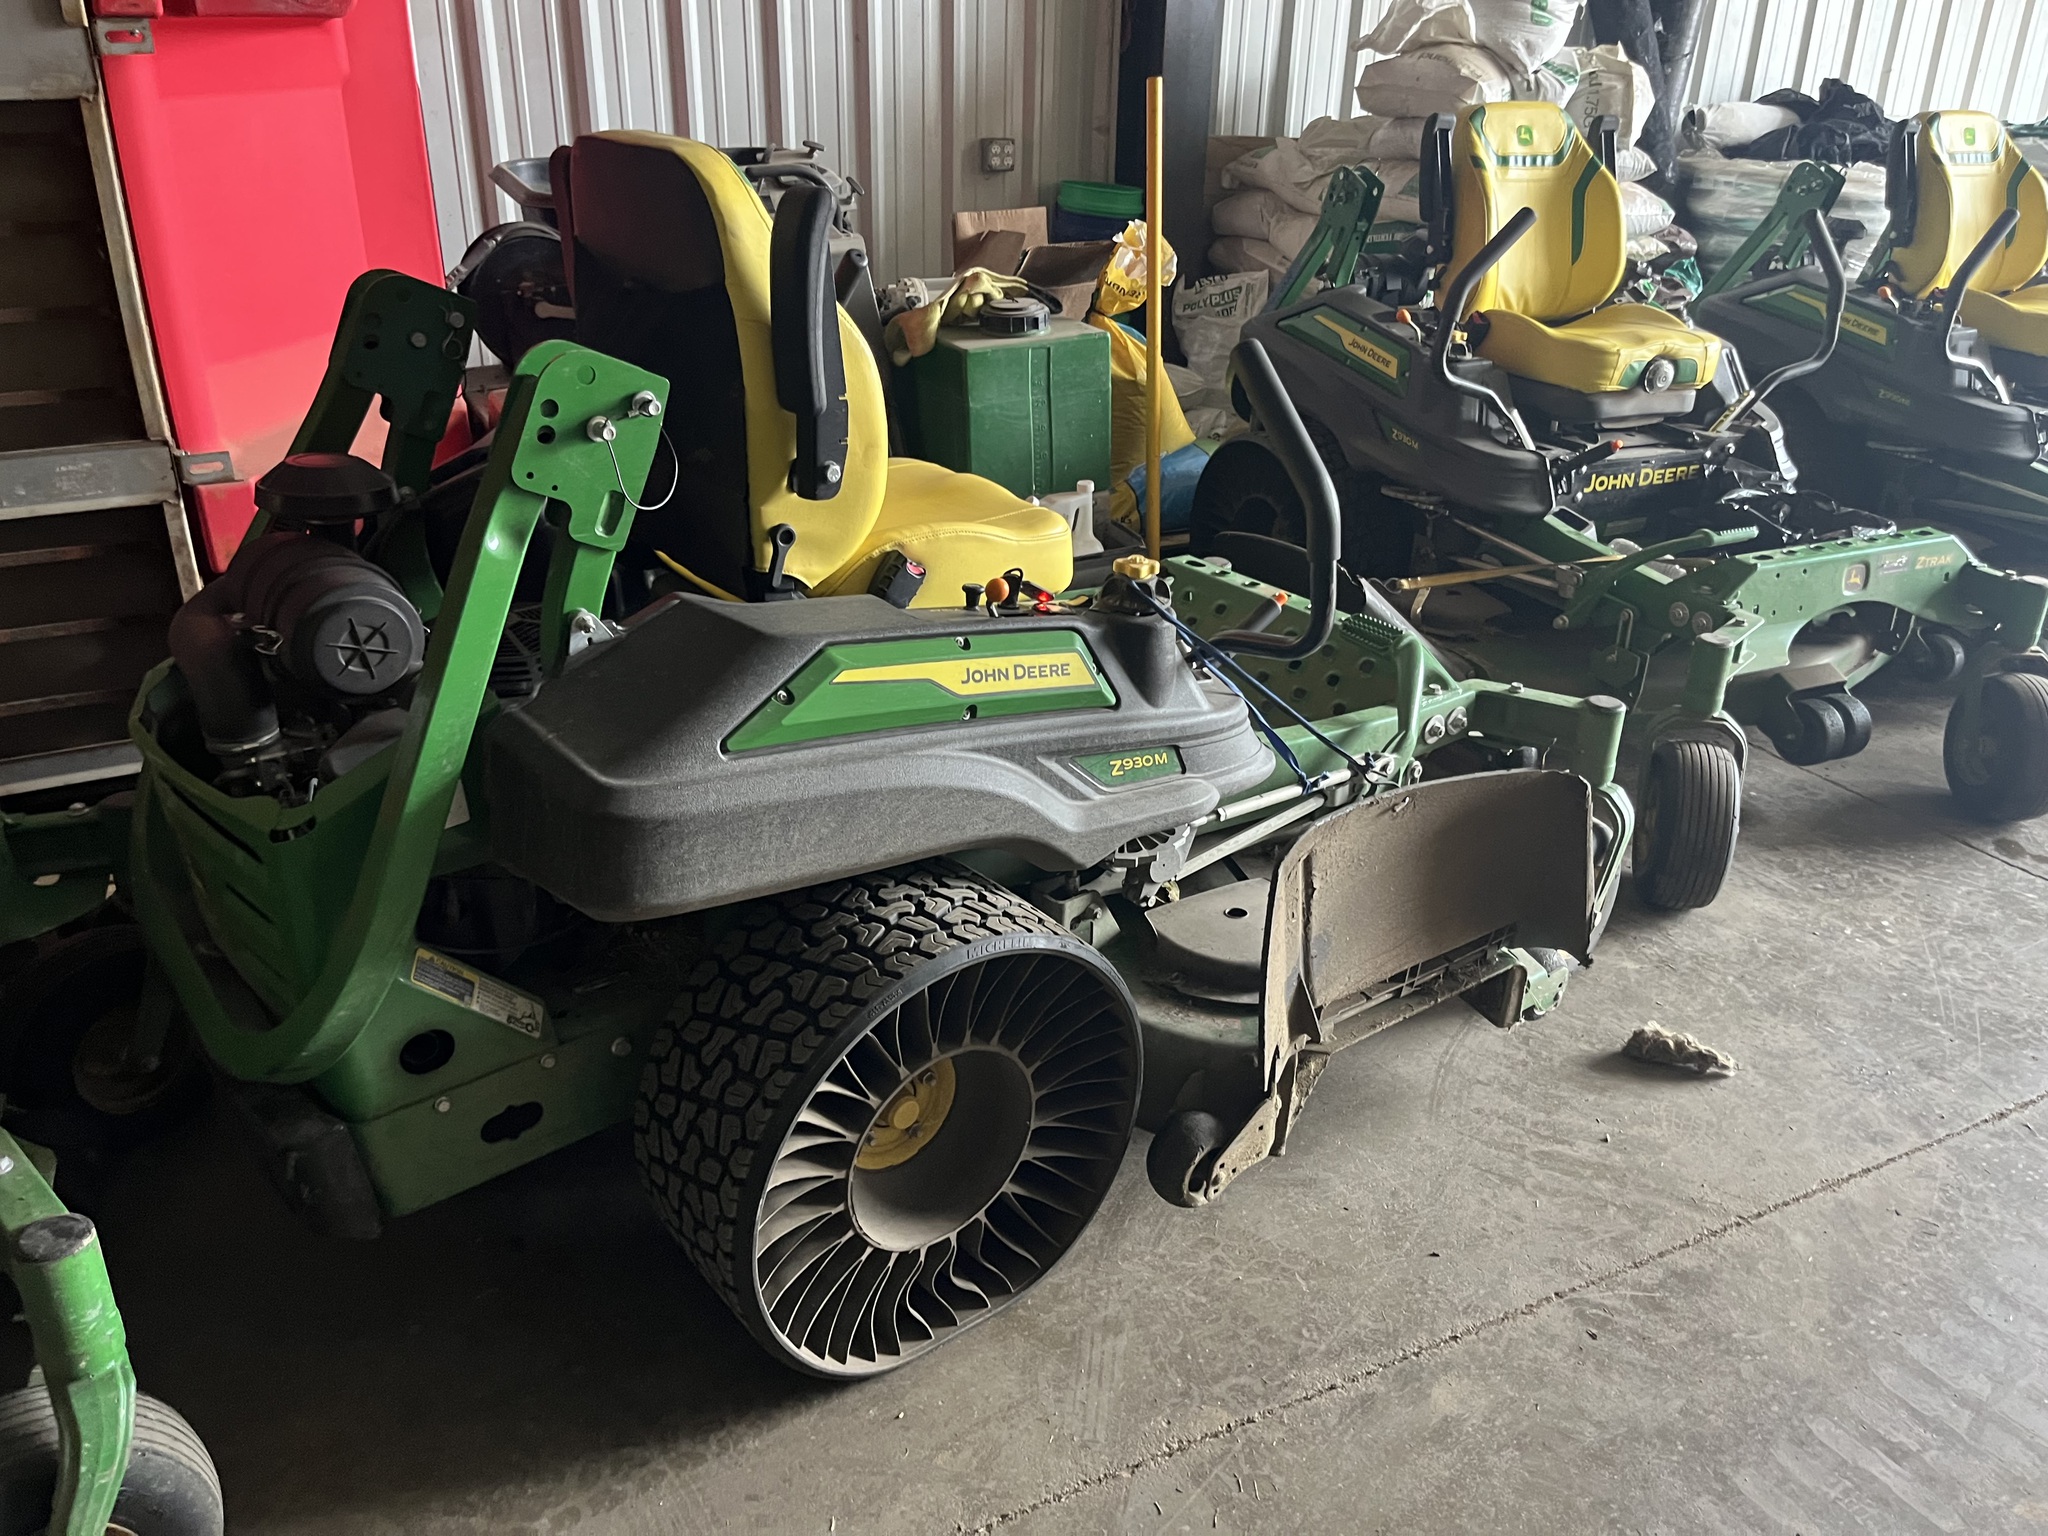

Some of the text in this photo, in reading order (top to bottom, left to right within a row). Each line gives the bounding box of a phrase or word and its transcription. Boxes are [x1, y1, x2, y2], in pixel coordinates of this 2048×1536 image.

[1182, 296, 1209, 313] POLY
[1211, 288, 1241, 307] PLUS
[1348, 338, 1392, 368] JOHN DEERE
[1584, 464, 1700, 494] JOHN DEERE
[960, 662, 1072, 685] JOHN DEERE
[1109, 752, 1169, 777] Z930M
